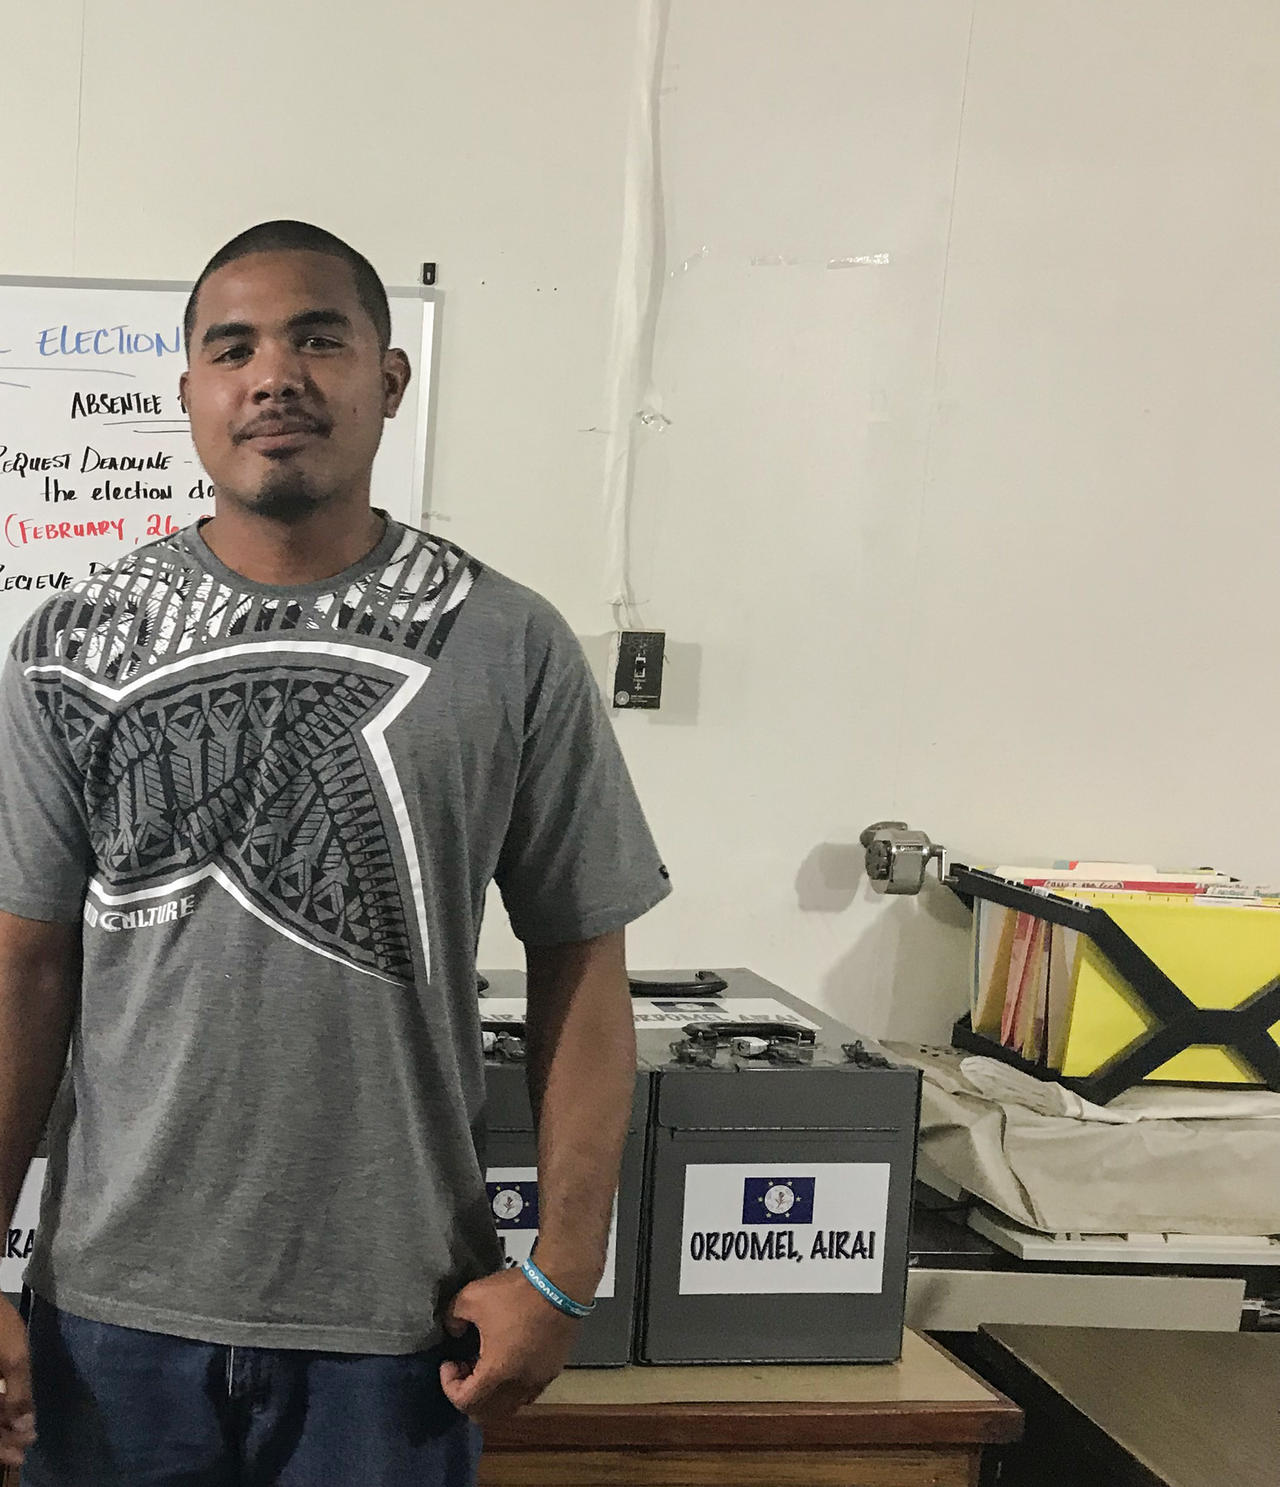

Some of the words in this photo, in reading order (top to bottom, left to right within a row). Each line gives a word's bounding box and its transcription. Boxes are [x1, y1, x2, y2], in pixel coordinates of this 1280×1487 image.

[35, 324, 182, 357] ELECTION
[70, 391, 162, 420] ABSENTEE
[80, 446, 173, 474] DEADLINE
[40, 476, 78, 503] the
[99, 894, 195, 933] CULTURE
[690, 1231, 803, 1264] ORDOMEL,
[810, 1230, 876, 1261] AIRAI
